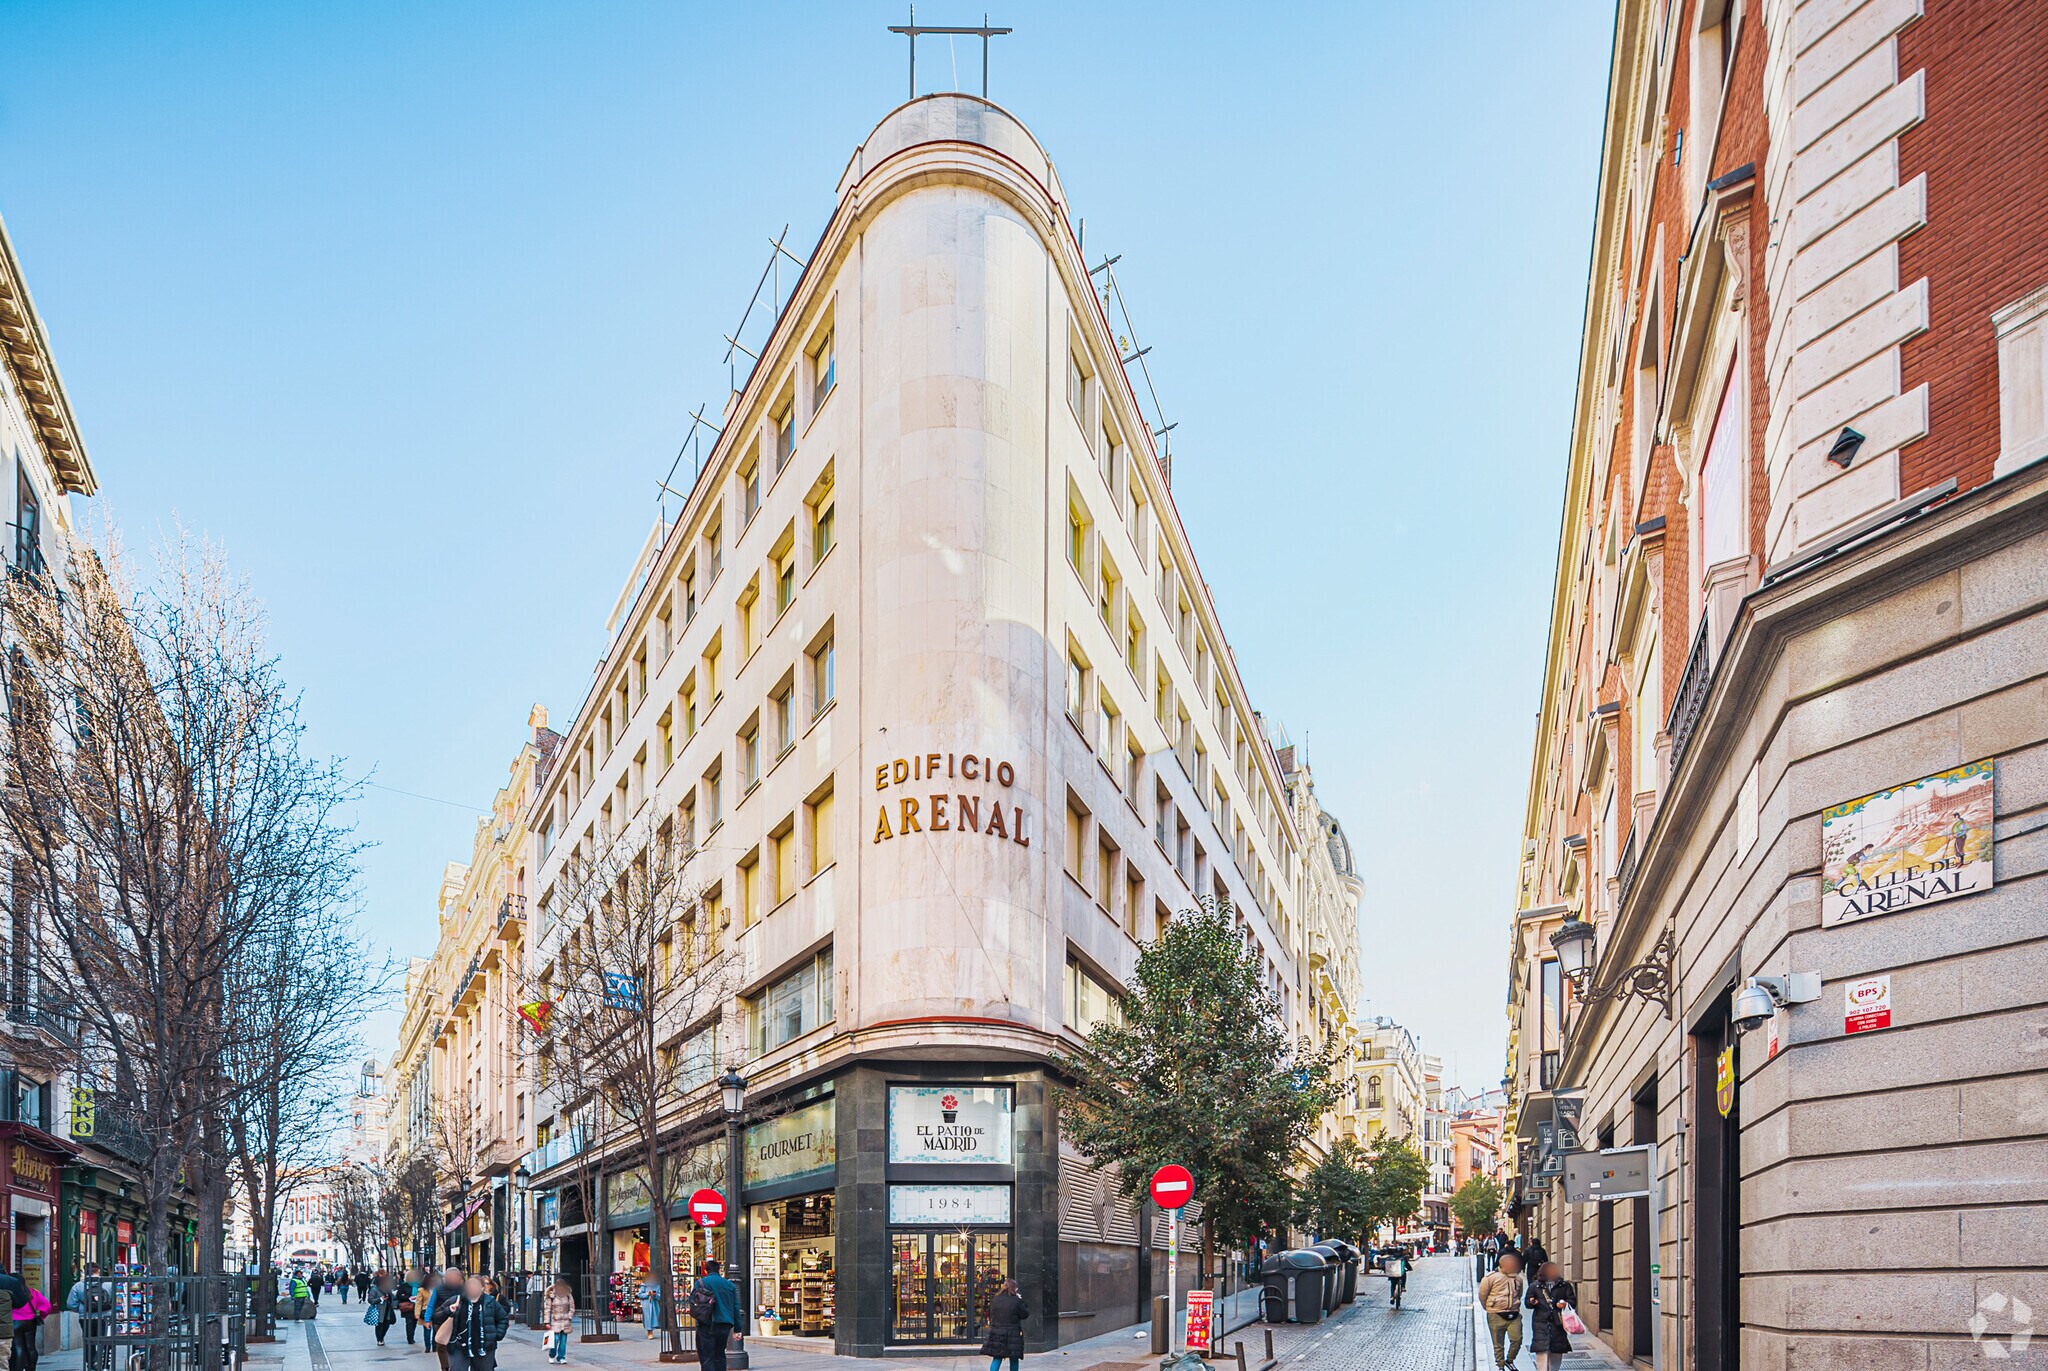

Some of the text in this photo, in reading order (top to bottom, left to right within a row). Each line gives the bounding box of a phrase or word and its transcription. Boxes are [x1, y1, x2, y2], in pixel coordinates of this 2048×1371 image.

[875, 753, 1015, 791] EDIFICIO
[873, 793, 1030, 847] ARENAL
[1839, 854, 1974, 898] CALLE DEL
[1836, 871, 1978, 921] ARENAL
[1857, 987, 1878, 998] BPS
[74, 1090, 92, 1134] ORO
[760, 1132, 813, 1161] GOURMET
[917, 1125, 985, 1137] EL PATIO DE
[923, 1136, 978, 1153] MADRID
[929, 1198, 972, 1209] 1984
